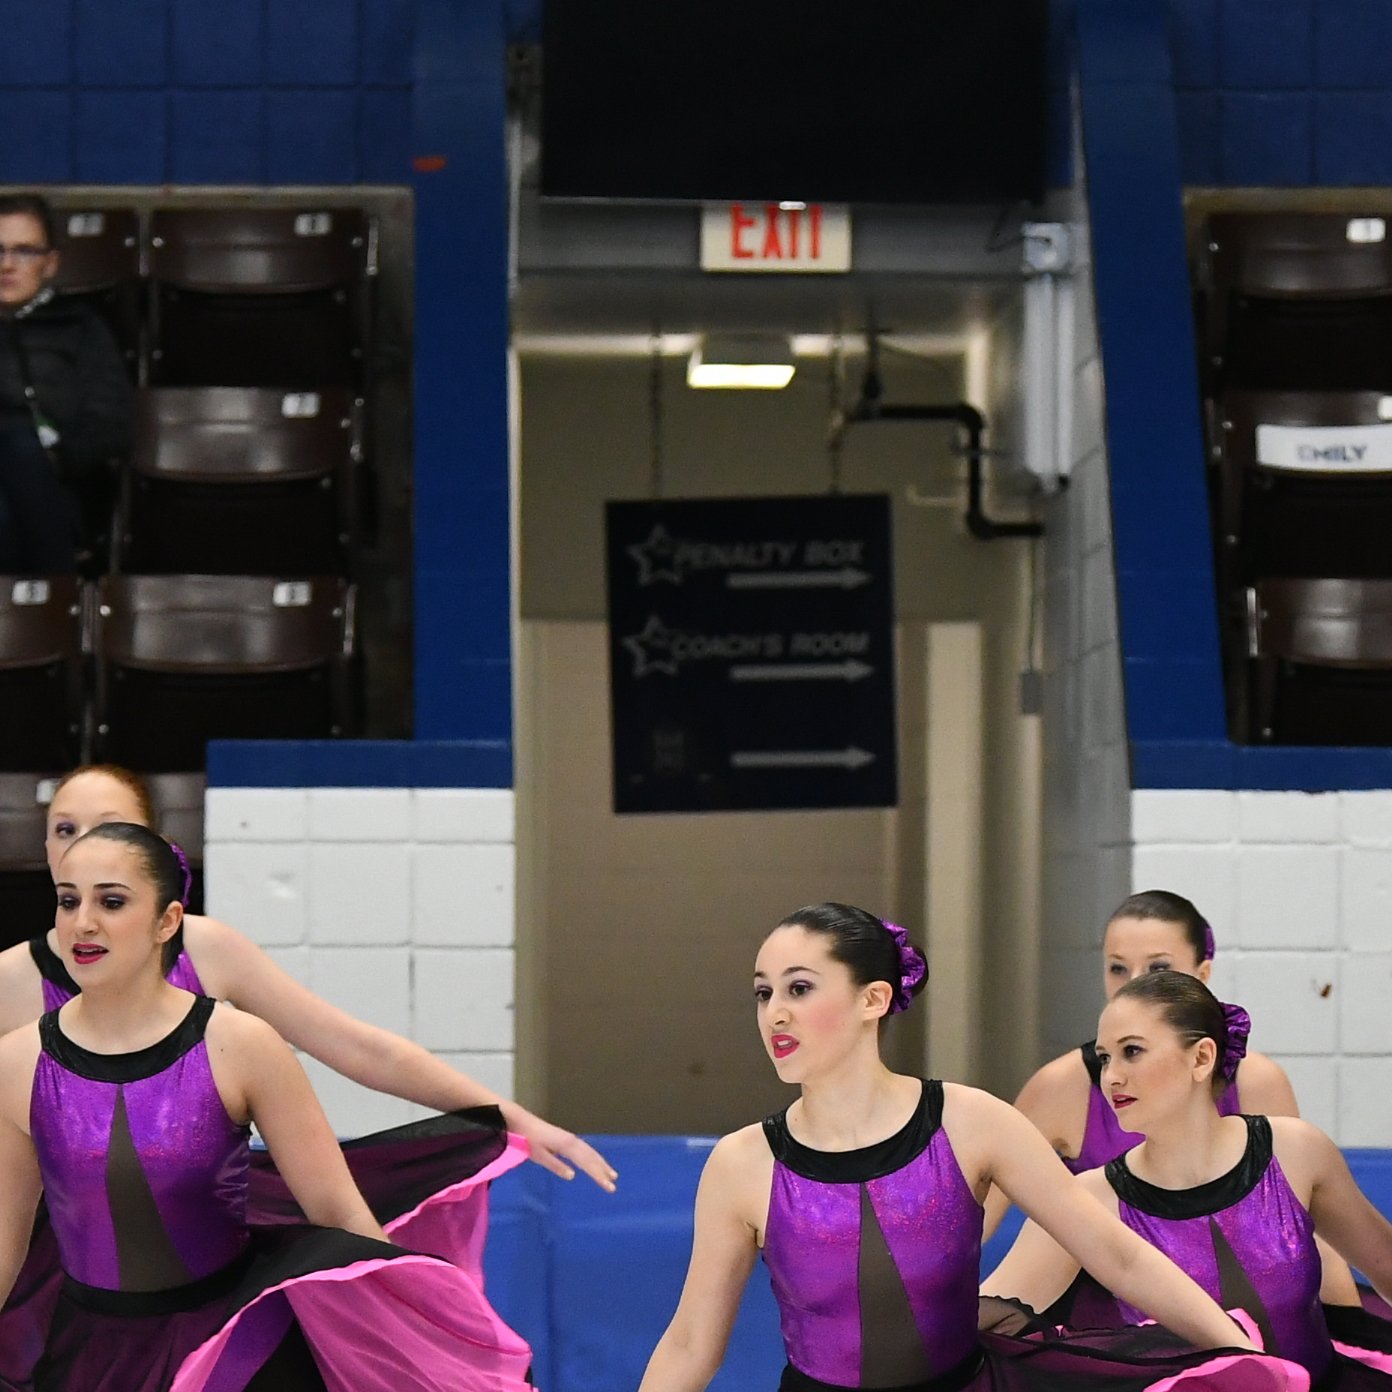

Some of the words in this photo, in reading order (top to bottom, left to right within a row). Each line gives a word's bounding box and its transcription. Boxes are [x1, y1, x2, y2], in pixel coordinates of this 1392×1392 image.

[674, 540, 798, 570] PENALTY
[803, 539, 865, 566] BOX
[672, 632, 784, 661] COACH'S
[788, 631, 871, 658] ROOM
